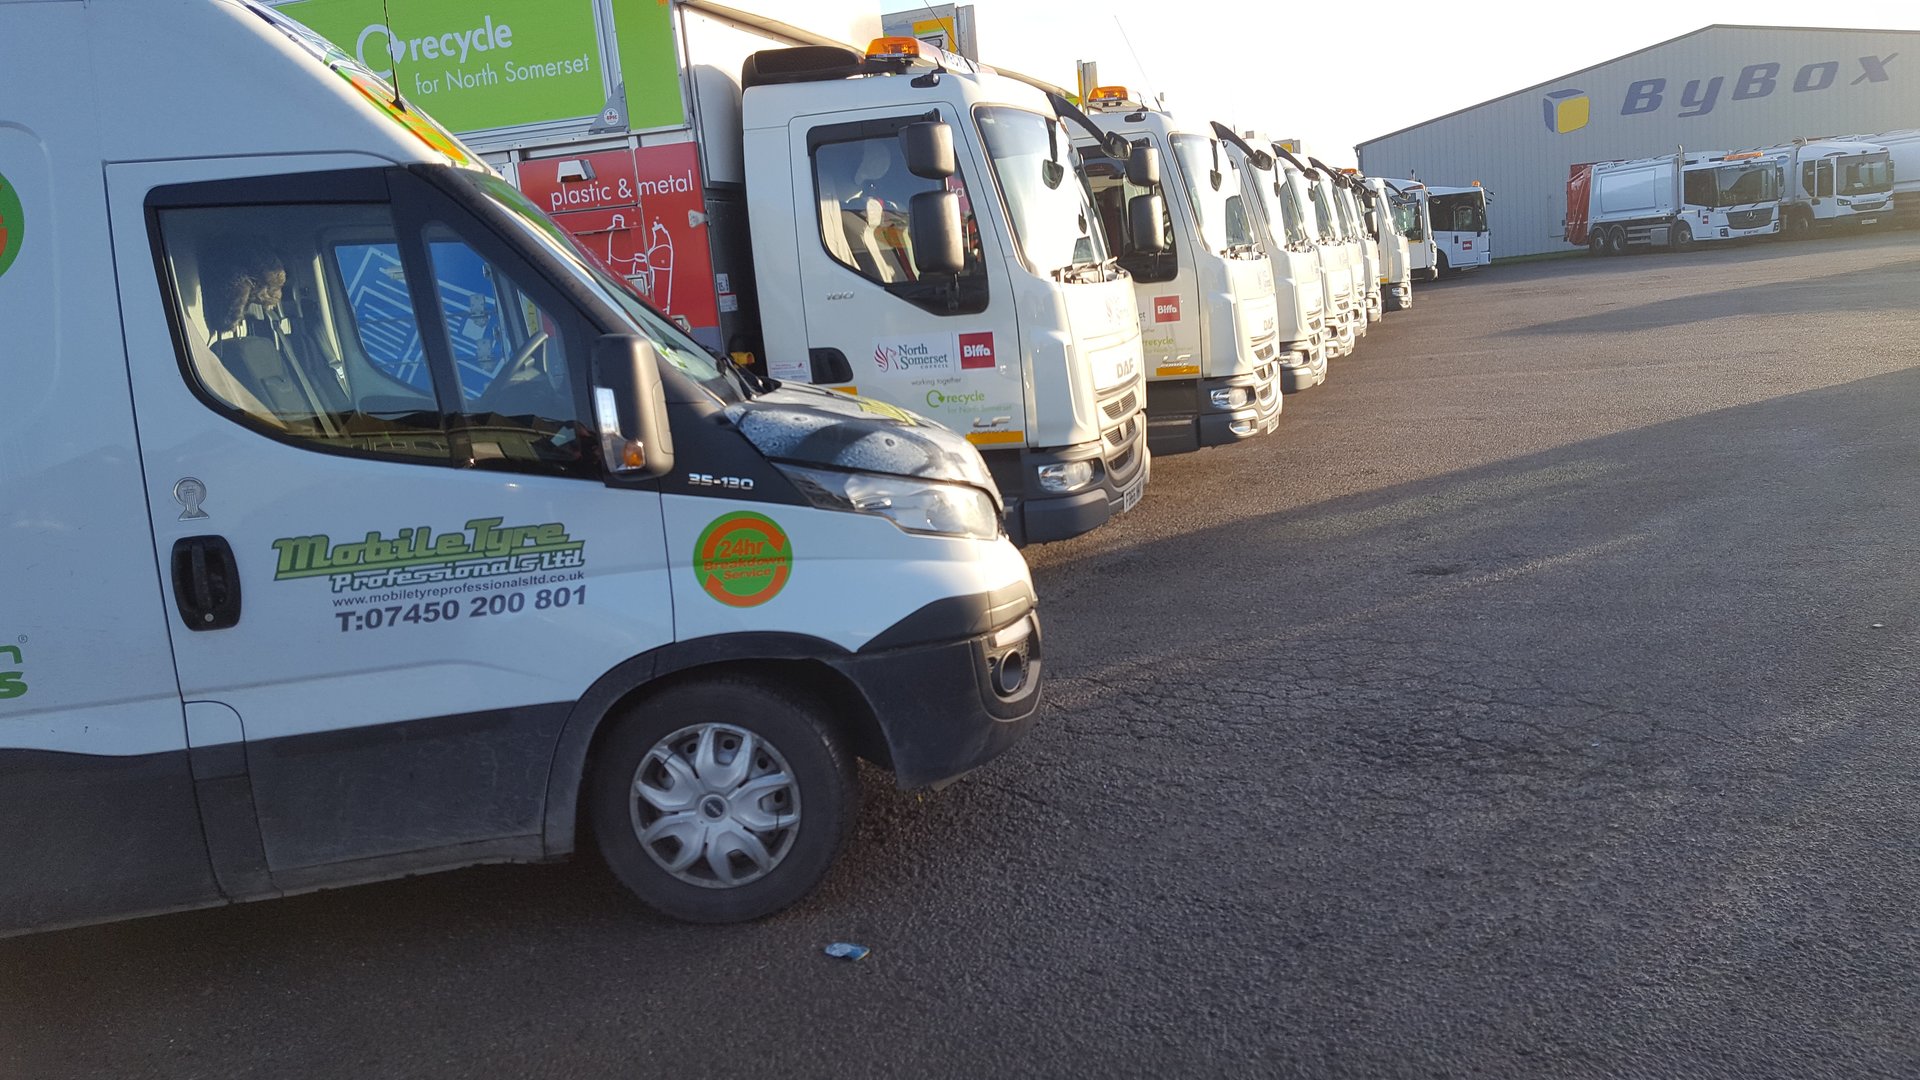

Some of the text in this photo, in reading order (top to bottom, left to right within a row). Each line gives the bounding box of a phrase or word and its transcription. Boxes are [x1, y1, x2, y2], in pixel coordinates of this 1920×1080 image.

[410, 15, 512, 63] recycle
[415, 53, 590, 95] for North Somerset
[550, 169, 694, 211] plastic & metal
[1157, 304, 1178, 315] Biffa
[898, 343, 928, 356] North
[963, 344, 991, 358] Biffa
[900, 353, 948, 370] Somerset
[1116, 357, 1134, 379] DAF
[946, 390, 985, 405] recycle
[688, 473, 754, 490] 35-130
[720, 538, 766, 559] 24hr
[704, 556, 785, 572] Breakdown
[724, 568, 771, 580] Service
[332, 571, 585, 607] www.mobiletyreprofessionalsltd.co.uk
[335, 584, 586, 632] T:07450 200 801
